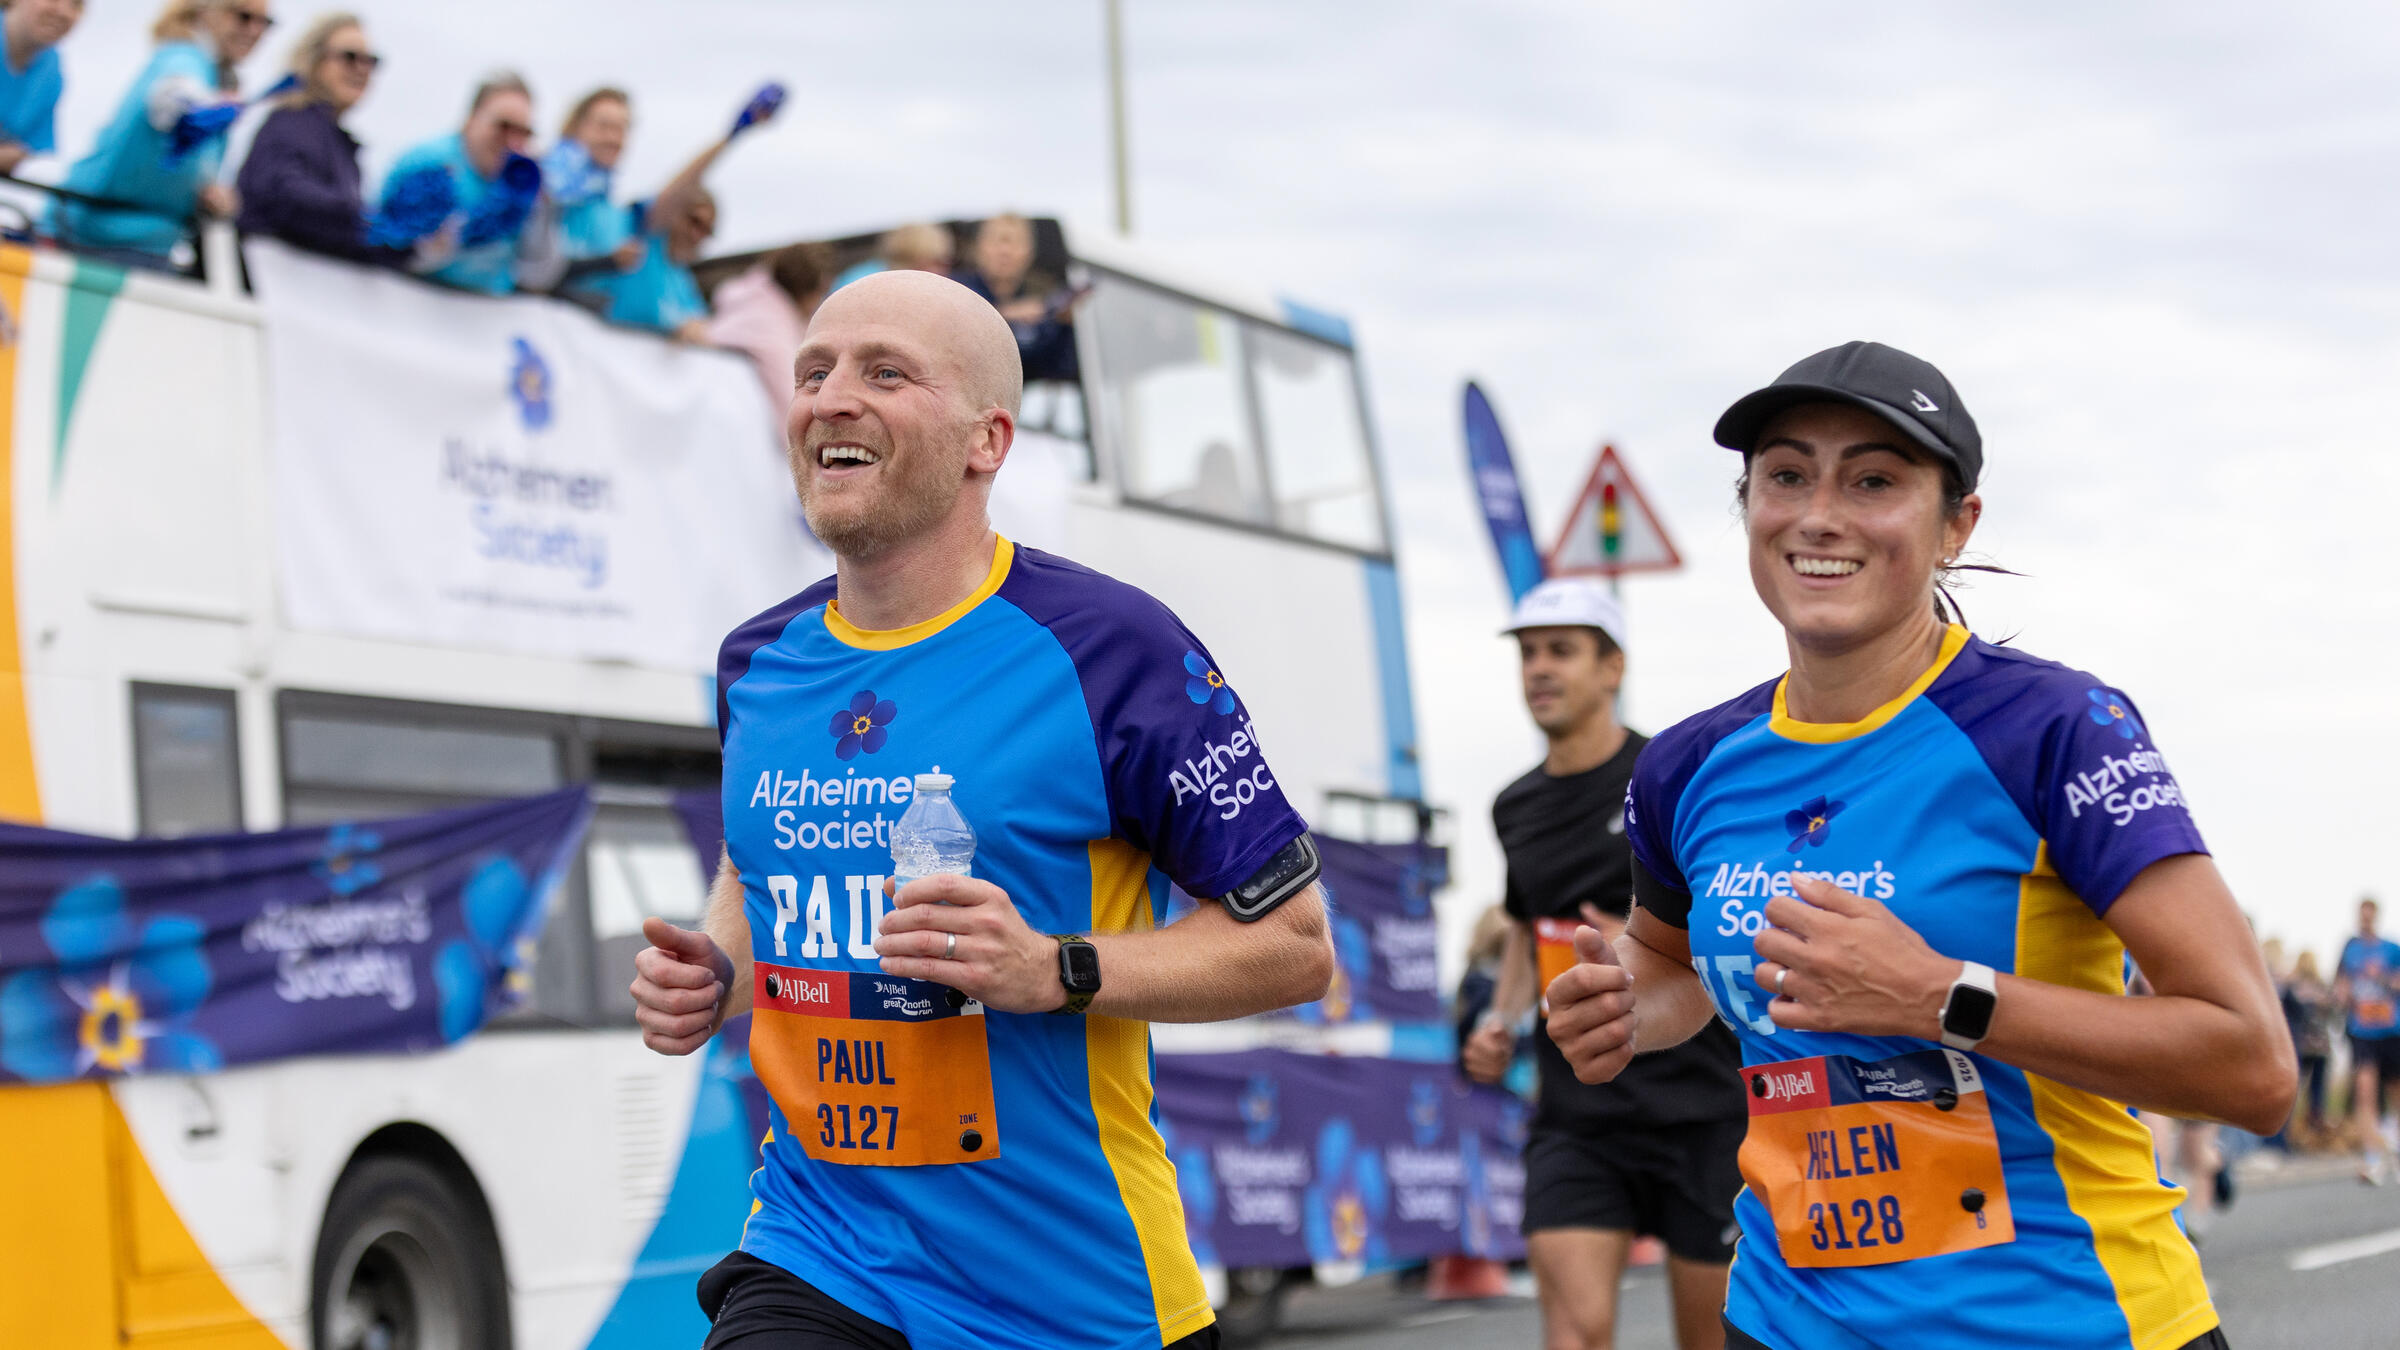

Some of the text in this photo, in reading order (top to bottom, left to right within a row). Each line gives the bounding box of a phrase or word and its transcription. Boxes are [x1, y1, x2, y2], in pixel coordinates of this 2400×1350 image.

[773, 809, 895, 850] Societ
[767, 874, 885, 960] PAU
[275, 948, 417, 1011] Society
[783, 978, 830, 1004] AJBell
[883, 1000, 931, 1009] great north
[817, 1038, 895, 1085] PAUL
[1775, 1071, 1815, 1102] AJBell
[817, 1103, 899, 1150] 3127
[959, 1113, 978, 1124] ZONE
[1806, 1122, 1901, 1180] HELEN
[1808, 1195, 1905, 1251] 3128
